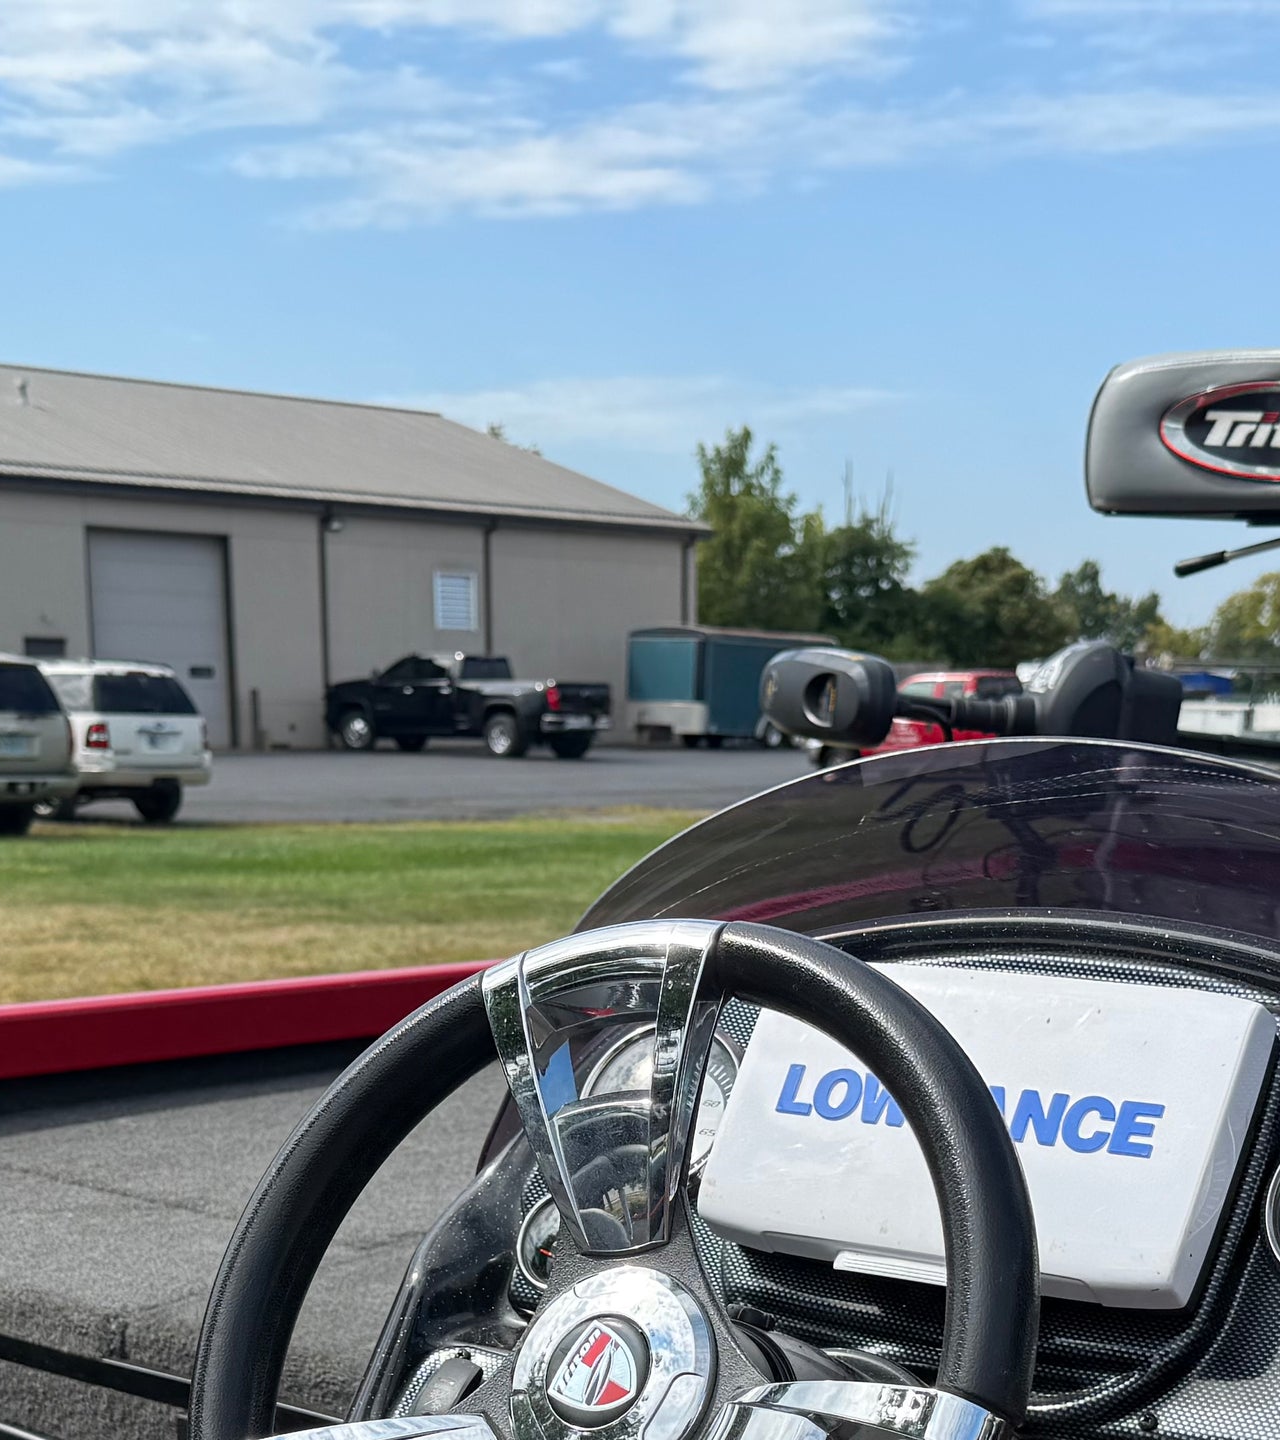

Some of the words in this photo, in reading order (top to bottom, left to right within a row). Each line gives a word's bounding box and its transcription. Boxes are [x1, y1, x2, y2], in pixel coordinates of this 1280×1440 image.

[703, 1100, 721, 1108] 60
[775, 1063, 1165, 1158] LOWNCE
[699, 1128, 715, 1136] 65
